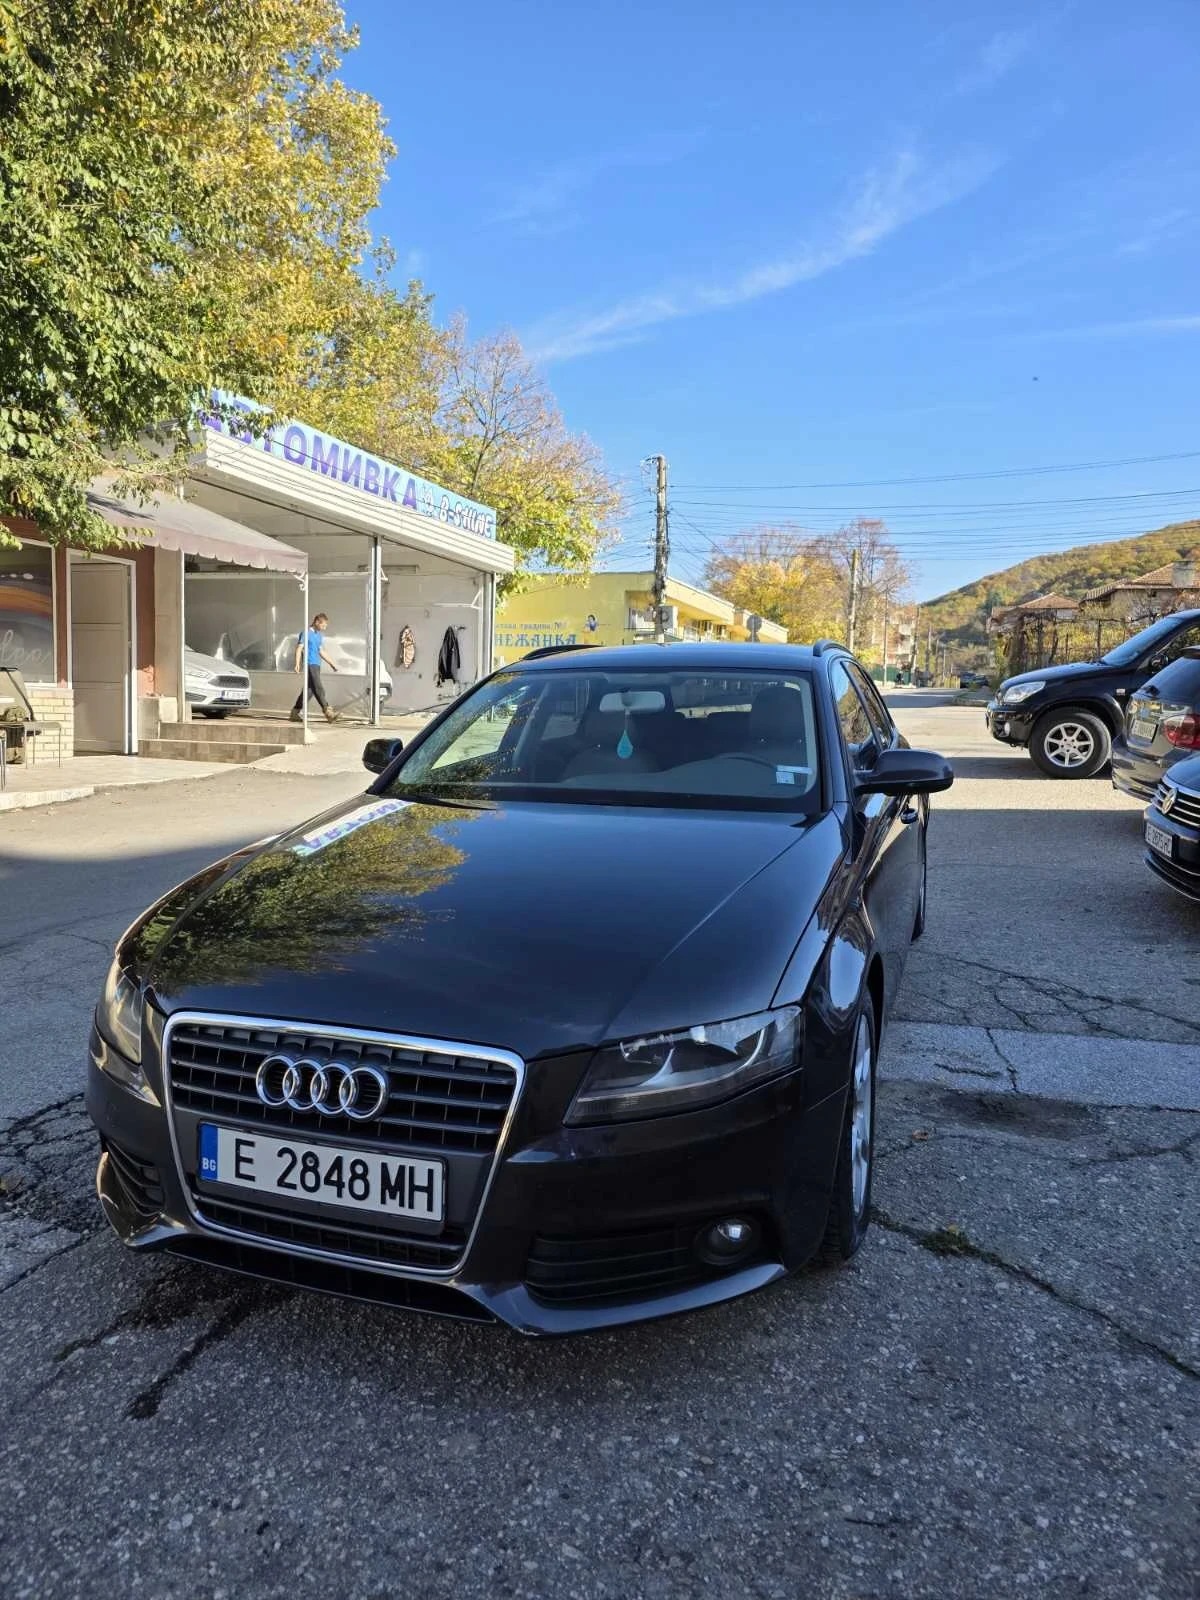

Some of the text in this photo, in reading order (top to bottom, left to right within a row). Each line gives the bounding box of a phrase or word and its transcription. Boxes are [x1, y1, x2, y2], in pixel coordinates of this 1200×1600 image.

[202, 1157, 217, 1172] BG
[234, 1138, 435, 1212] E 2848 MH
